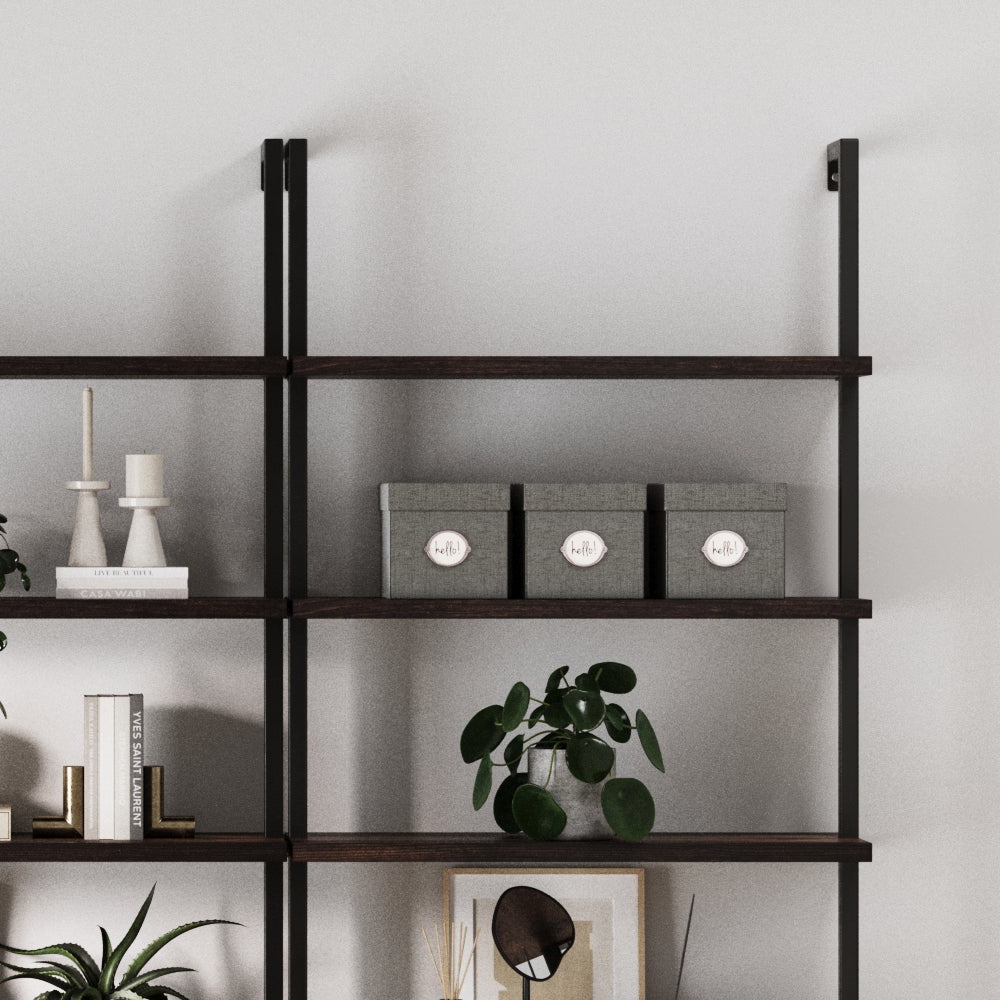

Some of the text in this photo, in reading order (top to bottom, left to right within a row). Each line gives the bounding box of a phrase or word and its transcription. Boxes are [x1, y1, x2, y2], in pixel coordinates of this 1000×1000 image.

[435, 540, 460, 557] hello!
[571, 540, 597, 557] hello!
[712, 540, 738, 557] hello!
[80, 590, 146, 599] CASA WABI
[132, 711, 142, 828] YVES SAINT LAURENT
